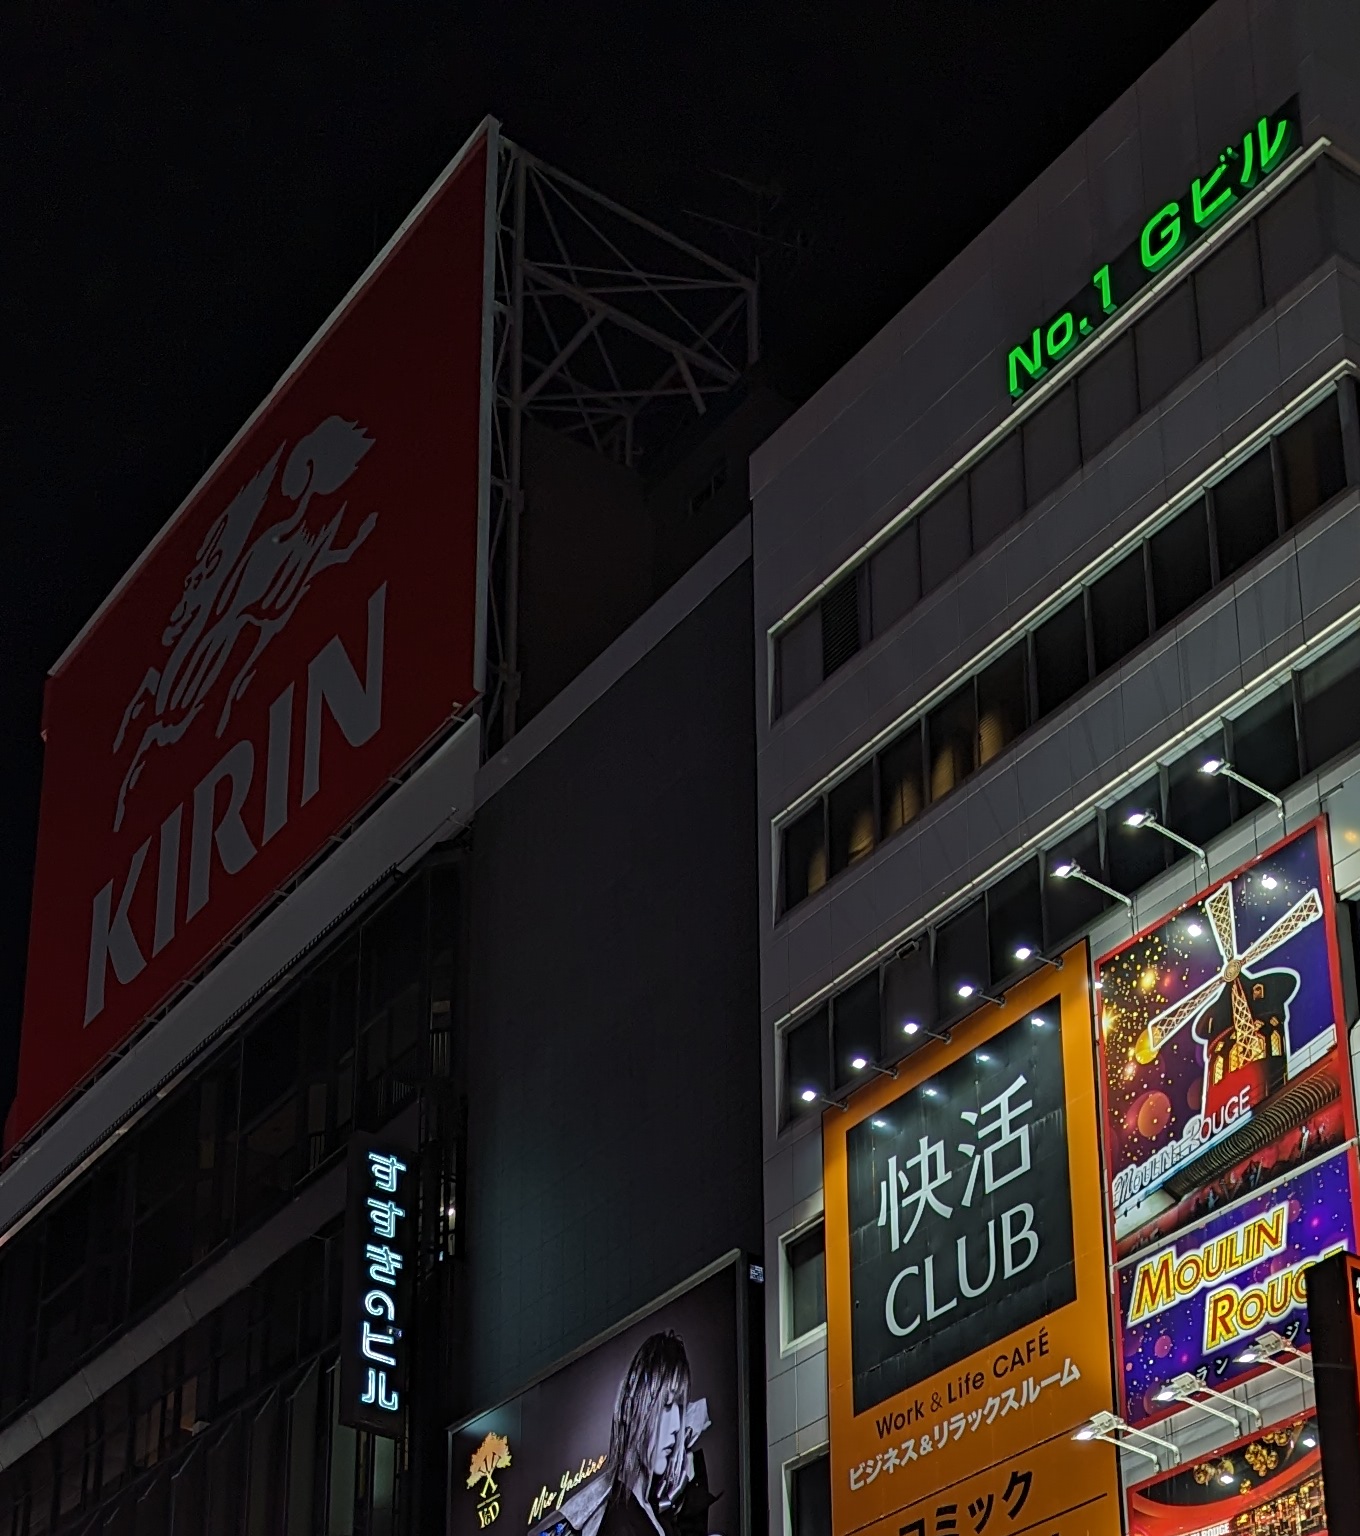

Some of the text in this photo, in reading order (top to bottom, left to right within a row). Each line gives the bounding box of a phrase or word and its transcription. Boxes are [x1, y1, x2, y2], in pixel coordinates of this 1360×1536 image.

[1141, 117, 1295, 274] Gビル
[83, 580, 388, 1030] KIRIN
[877, 1074, 1034, 1253] 快活
[360, 1150, 407, 1411] すすきのビル
[884, 1203, 1040, 1338] CLUB
[849, 1357, 1082, 1493] ビジネス&リラックスルーム
[875, 1327, 1051, 1440] Work & Life CAFÉ
